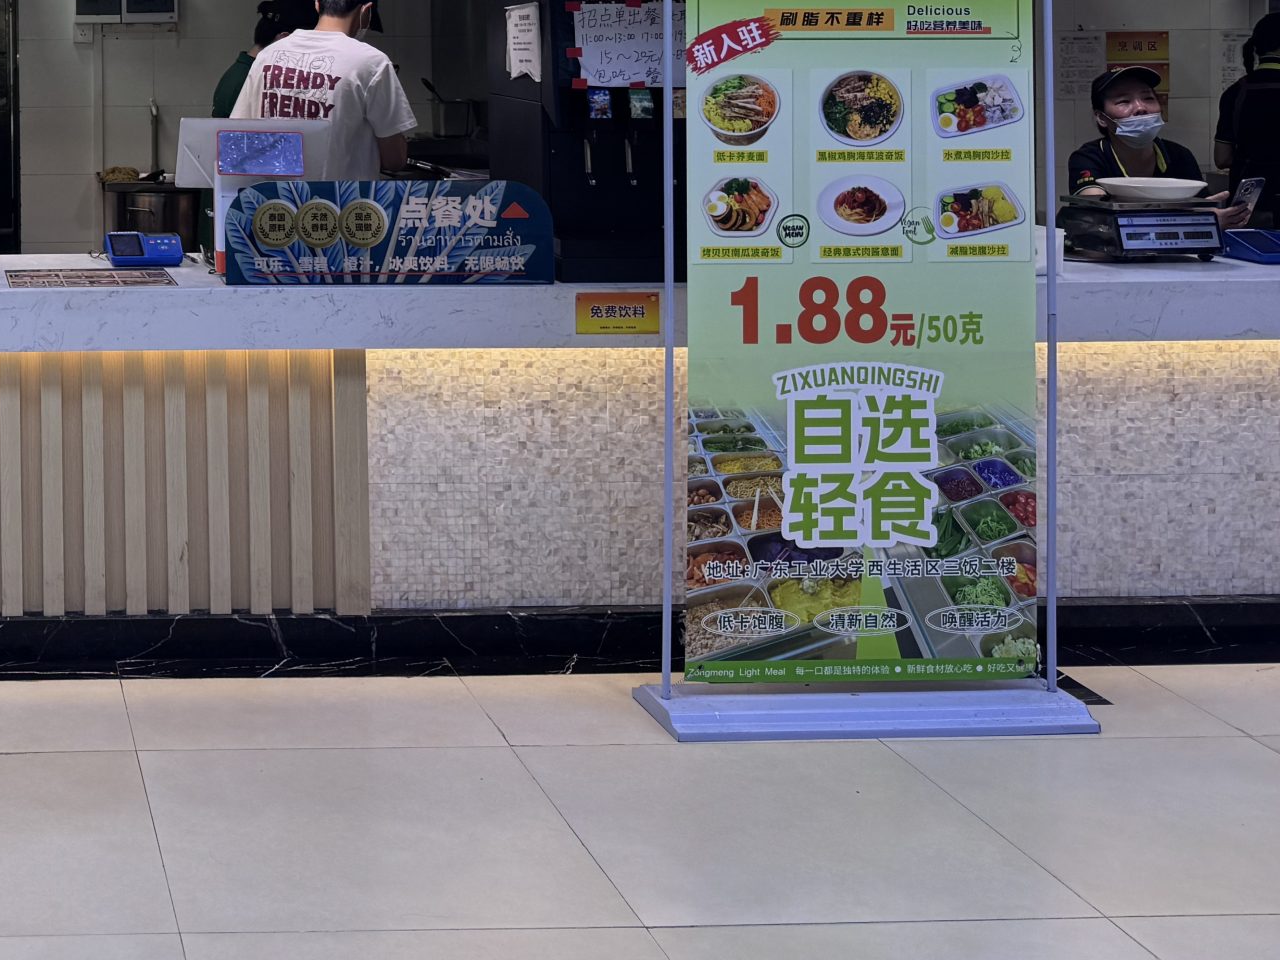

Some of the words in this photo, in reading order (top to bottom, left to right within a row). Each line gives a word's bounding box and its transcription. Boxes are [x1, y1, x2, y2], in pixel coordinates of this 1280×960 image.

[907, 5, 971, 16] Delicious
[779, 11, 885, 27] 刷脂不重样
[906, 20, 984, 32] 好吃营养美味
[692, 20, 768, 68] 新入驻
[262, 64, 342, 91] TRENDY
[715, 151, 766, 162] 低卡荞麦面
[943, 149, 1011, 160] 水煮鸡胸肉沙拉
[268, 212, 286, 222] 泰国
[310, 212, 328, 222] 天然
[354, 212, 372, 222] 现点
[399, 195, 498, 229] 点餐处
[782, 224, 804, 233] VEGAN
[784, 231, 804, 239] MENU
[822, 246, 899, 257] 经典意式肉酱意面
[947, 244, 1007, 256] 减脂饱腹沙拉
[590, 305, 645, 318] 免费饮料
[776, 365, 940, 395] ZIXUANQINGSHI
[794, 394, 931, 465] 自选
[789, 471, 932, 541] 轻食
[705, 557, 1018, 579] 地址:广东工业大学西生活区三饭二楼
[716, 615, 785, 632] 低卡饱腹
[829, 613, 897, 630] 清新自然
[940, 613, 1009, 629] 唤醒活力
[739, 666, 760, 677] Light
[764, 666, 786, 676] Meal
[795, 665, 890, 676] 每一口都是独特的体验
[906, 664, 974, 675] 新鲜食材放心吃
